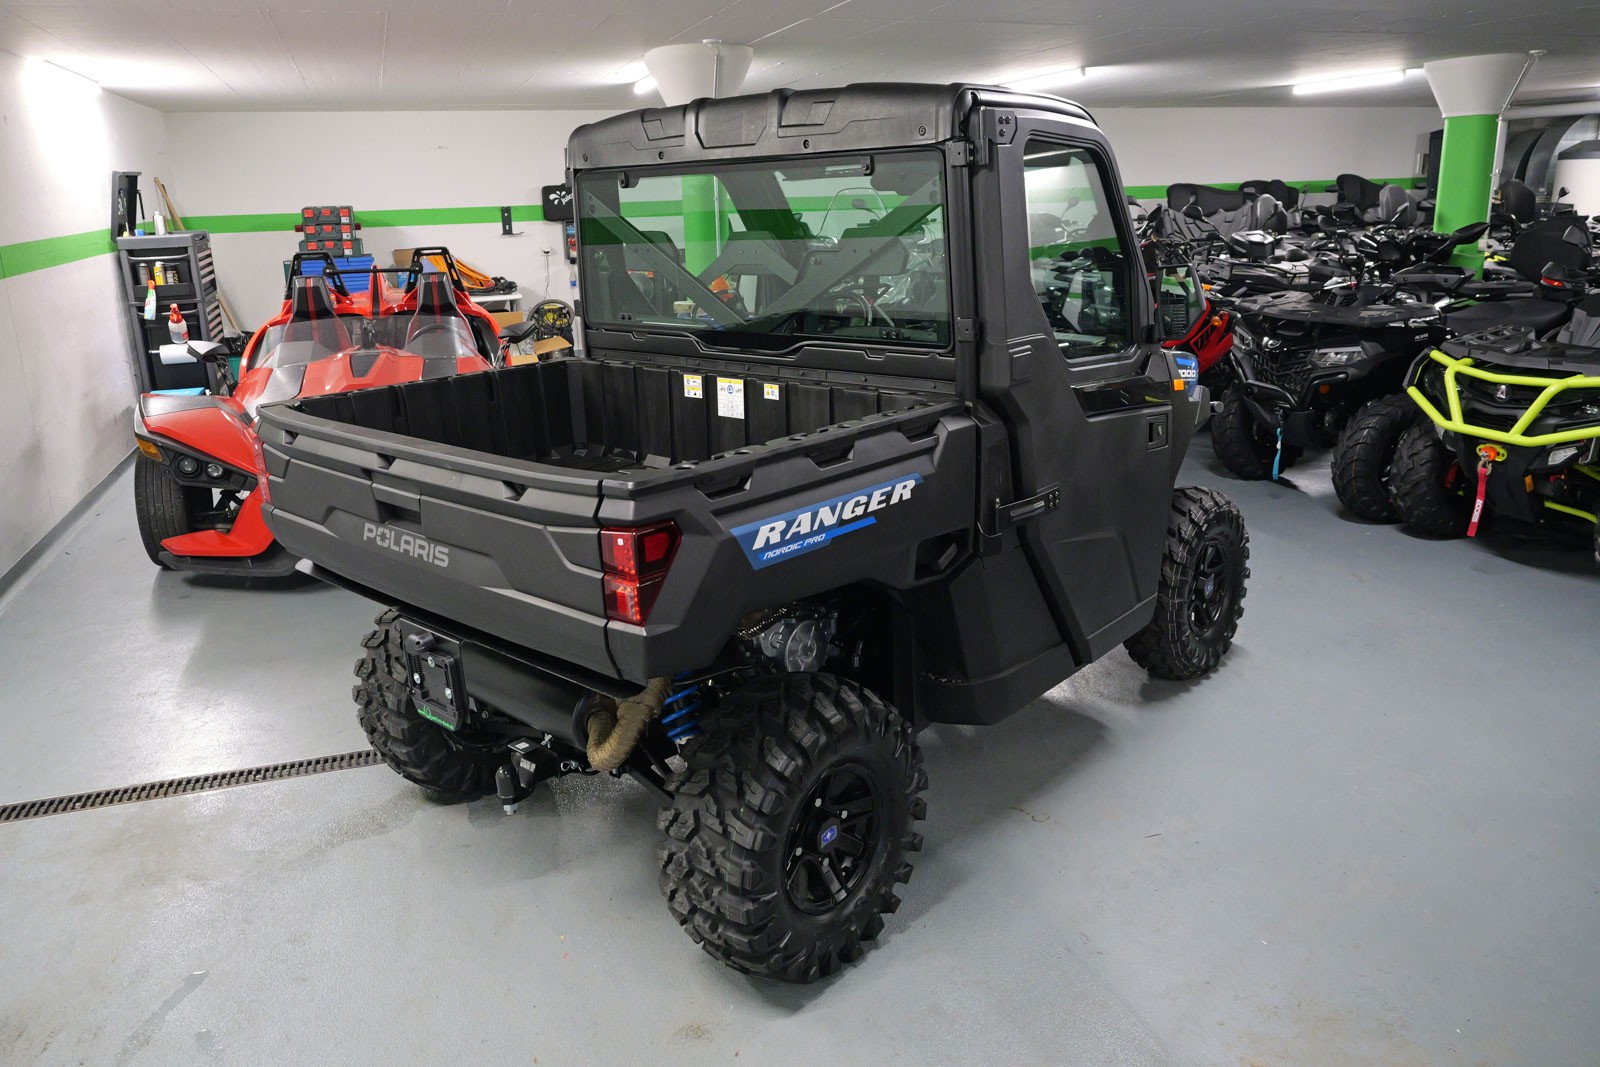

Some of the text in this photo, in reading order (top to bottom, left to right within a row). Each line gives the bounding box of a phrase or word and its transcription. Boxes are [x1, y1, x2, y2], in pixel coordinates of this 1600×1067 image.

[561, 193, 574, 205] juic
[752, 479, 916, 551] RANGER
[363, 522, 449, 568] POLARIS
[763, 533, 826, 561] NORDIC PRO
